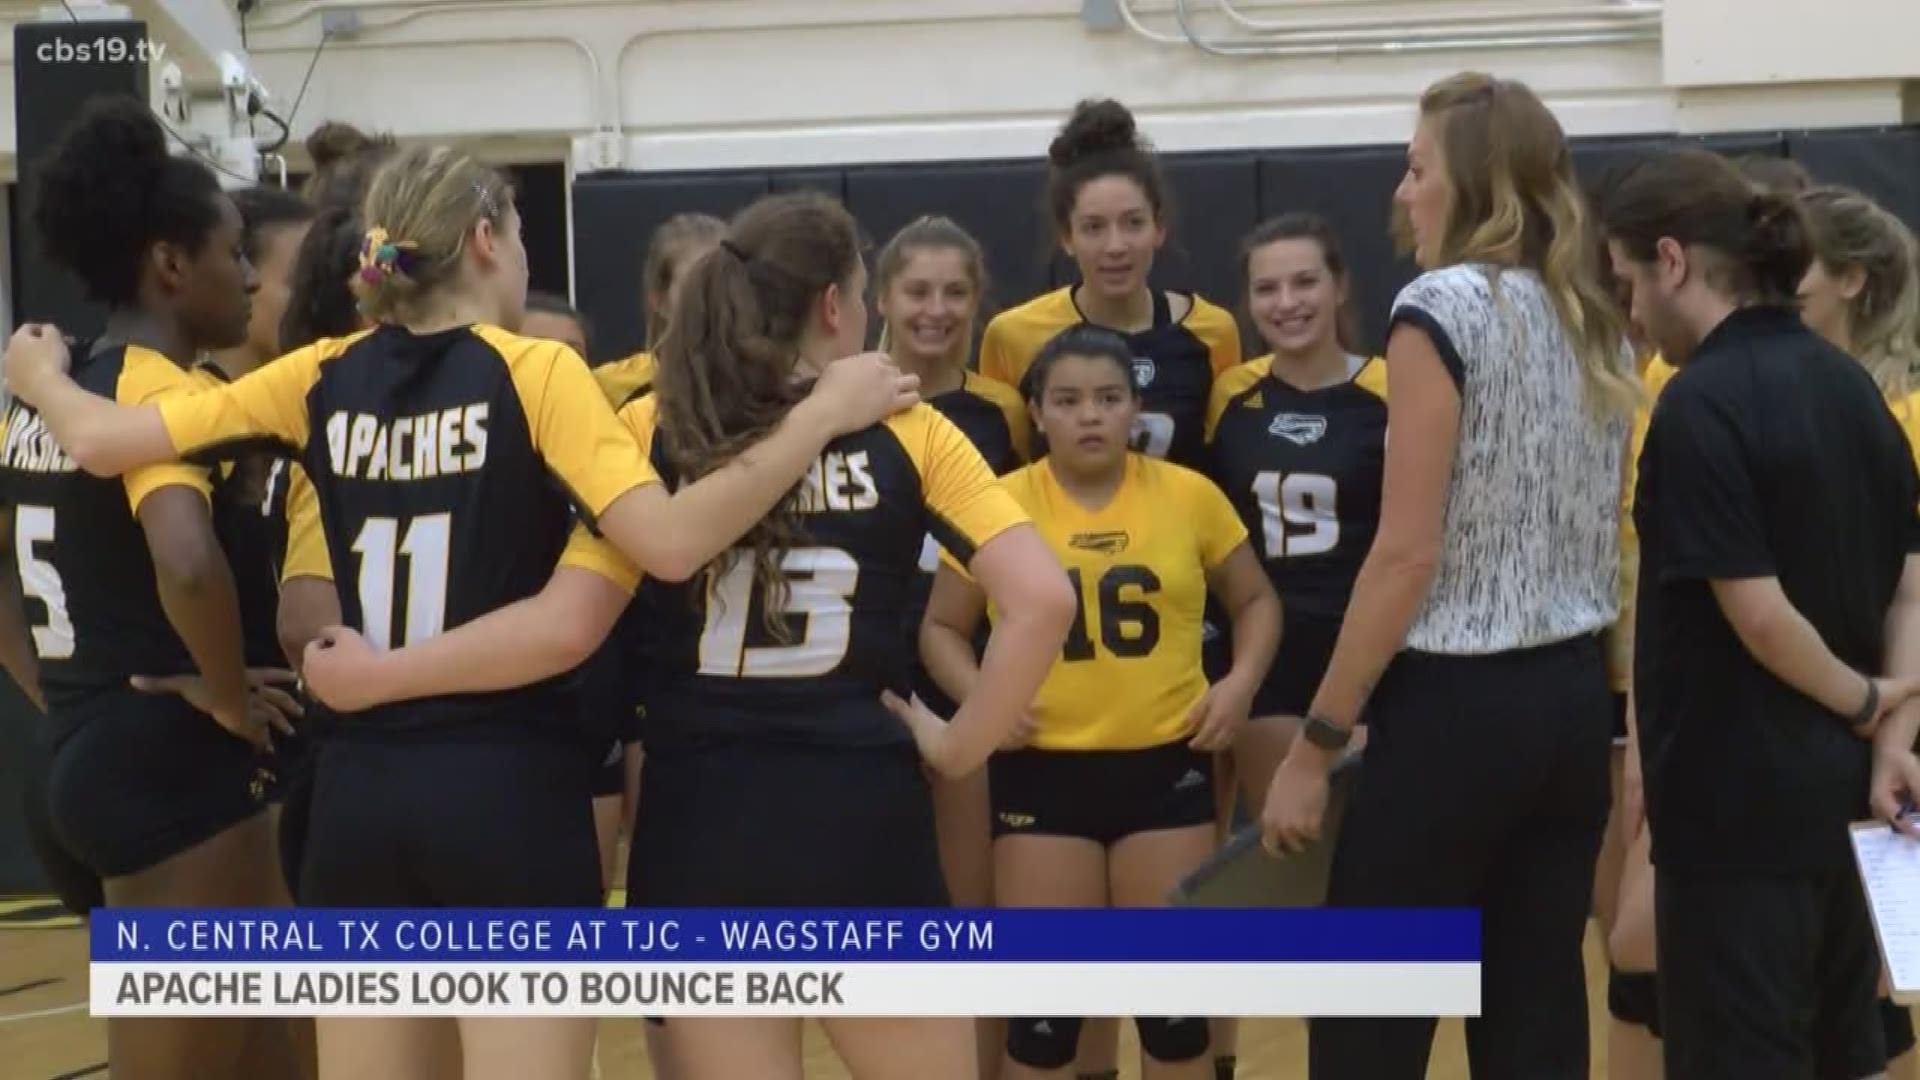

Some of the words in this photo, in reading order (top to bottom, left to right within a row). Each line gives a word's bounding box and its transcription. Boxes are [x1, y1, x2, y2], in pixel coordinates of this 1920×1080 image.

[326, 402, 489, 480] APACHES
[1251, 470, 1341, 558] 19
[15, 503, 76, 660] 5
[351, 511, 452, 654] 11
[696, 546, 860, 678] 13
[1062, 564, 1162, 662] 16
